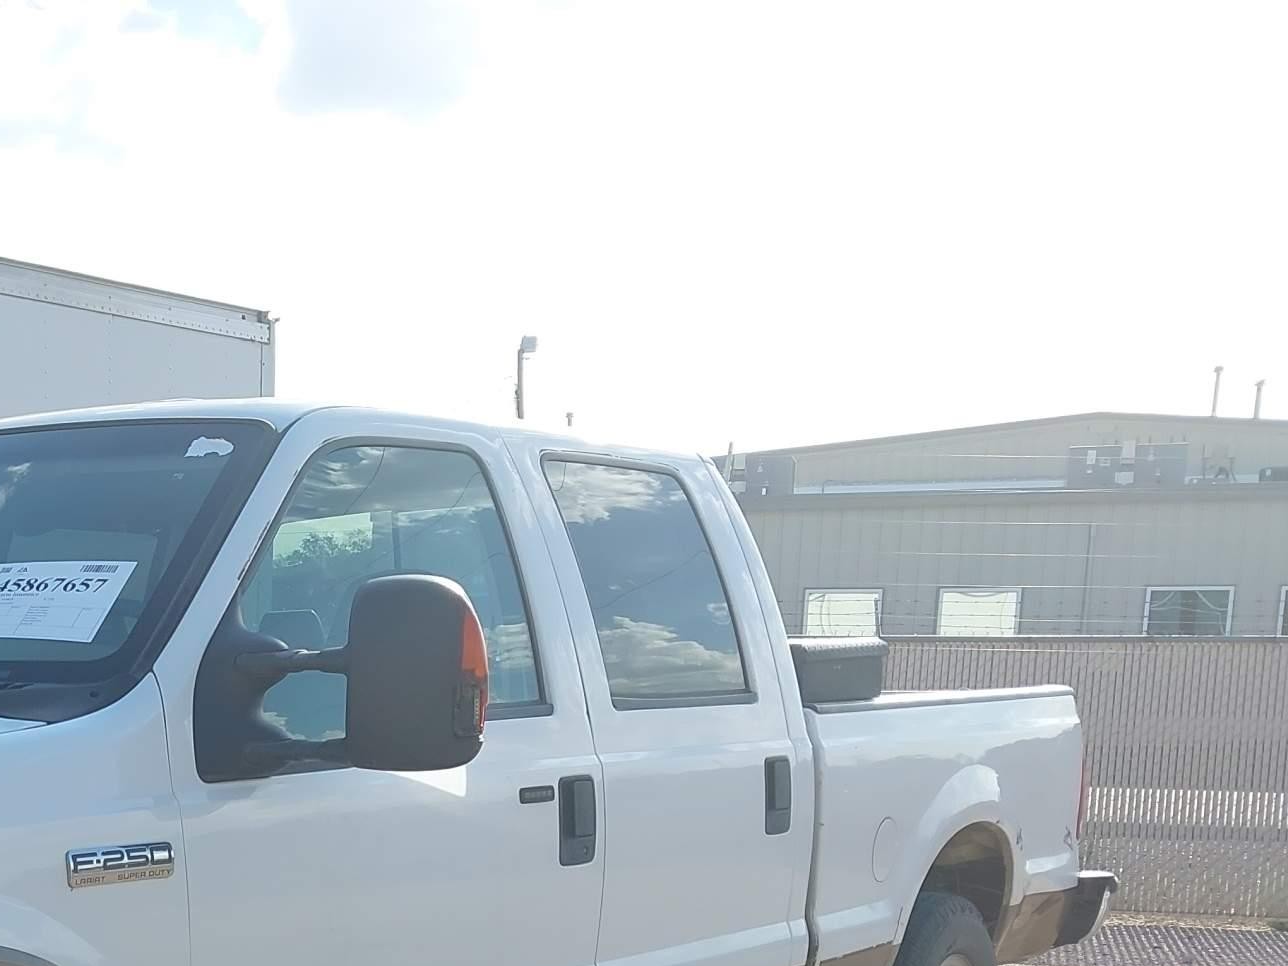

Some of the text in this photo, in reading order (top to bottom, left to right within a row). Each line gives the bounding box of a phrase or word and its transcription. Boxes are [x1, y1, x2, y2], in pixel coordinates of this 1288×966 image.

[71, 845, 173, 873] F-250
[117, 871, 147, 881] SUPER
[148, 869, 171, 877] DUTY
